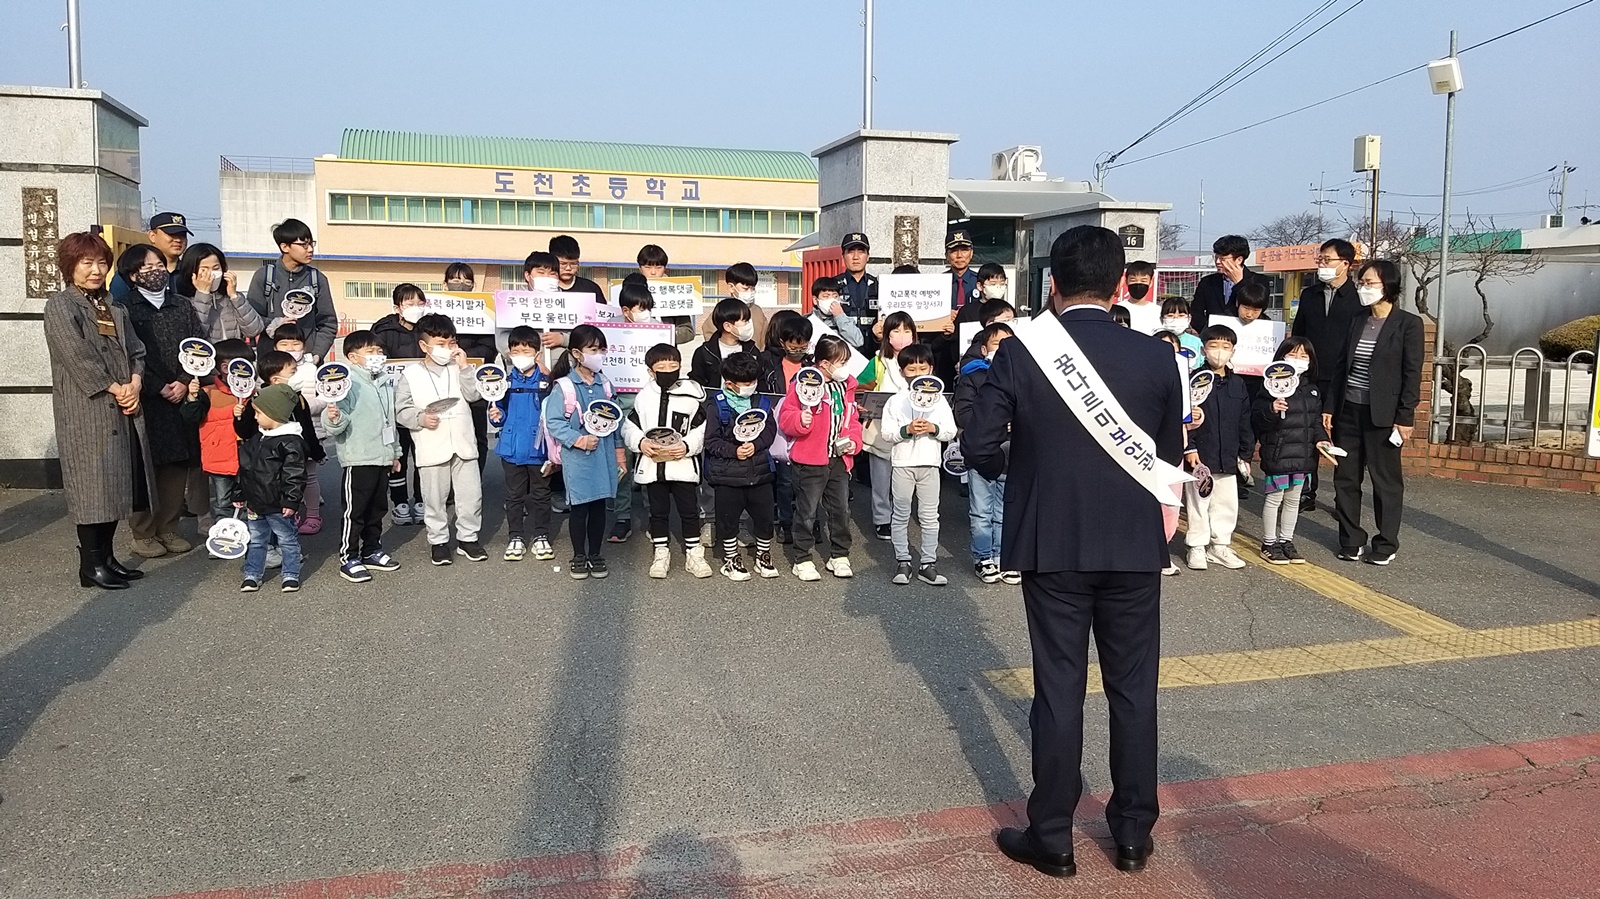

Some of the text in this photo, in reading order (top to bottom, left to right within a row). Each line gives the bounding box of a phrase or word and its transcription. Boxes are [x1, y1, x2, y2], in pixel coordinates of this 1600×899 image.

[494, 171, 700, 201] 도천초등학교
[42, 195, 58, 292] 도천초등학교
[900, 219, 913, 266] 도천초
[1126, 236, 1137, 246] 16
[27, 212, 41, 292] 병설유치원
[659, 284, 693, 295] 행복댓글
[445, 299, 485, 310] 하지말자
[507, 296, 566, 308] 주먹 한방에
[660, 298, 694, 309] 고운댓글
[886, 301, 913, 310] 우리모두
[520, 312, 543, 323] 부모
[546, 312, 578, 325] 울린다
[596, 309, 615, 318] 보자
[451, 315, 485, 327] 라한다
[606, 344, 653, 355] 추고 살피
[386, 365, 405, 374] 친구
